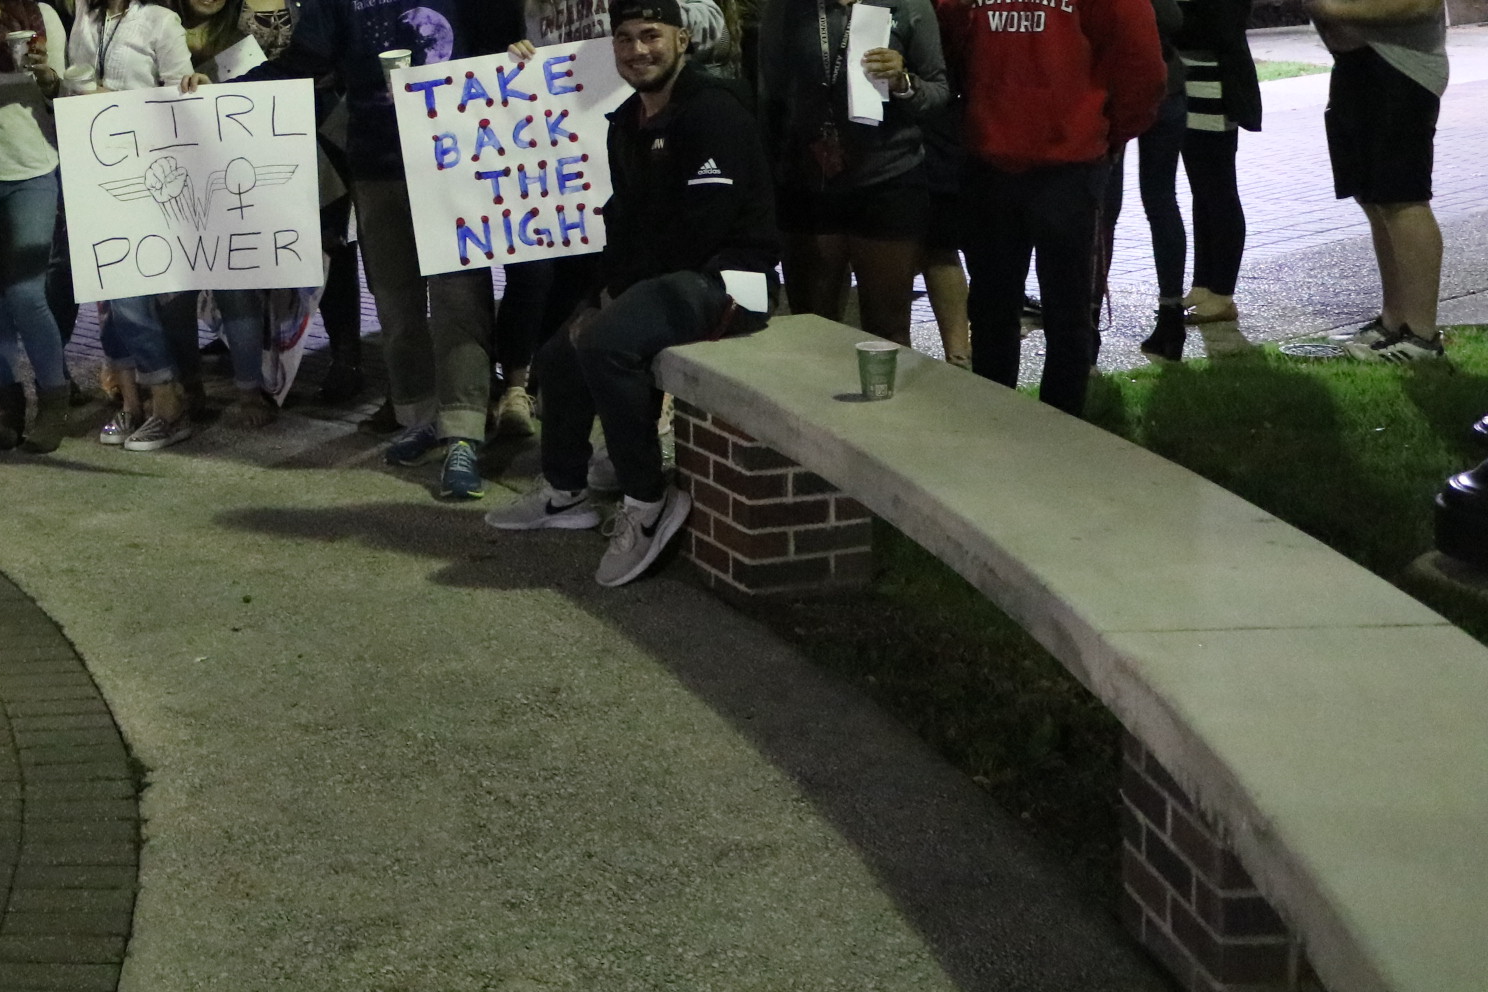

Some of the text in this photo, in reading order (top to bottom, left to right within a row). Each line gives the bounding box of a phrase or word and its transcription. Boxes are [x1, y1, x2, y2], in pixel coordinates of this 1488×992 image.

[987, 11, 1046, 33] WORD
[404, 53, 584, 119] TAKE
[90, 94, 308, 166] GIRL
[432, 109, 579, 170] BACK
[474, 153, 591, 205] THE
[92, 229, 302, 289] POWER
[455, 202, 603, 266] NIGH
